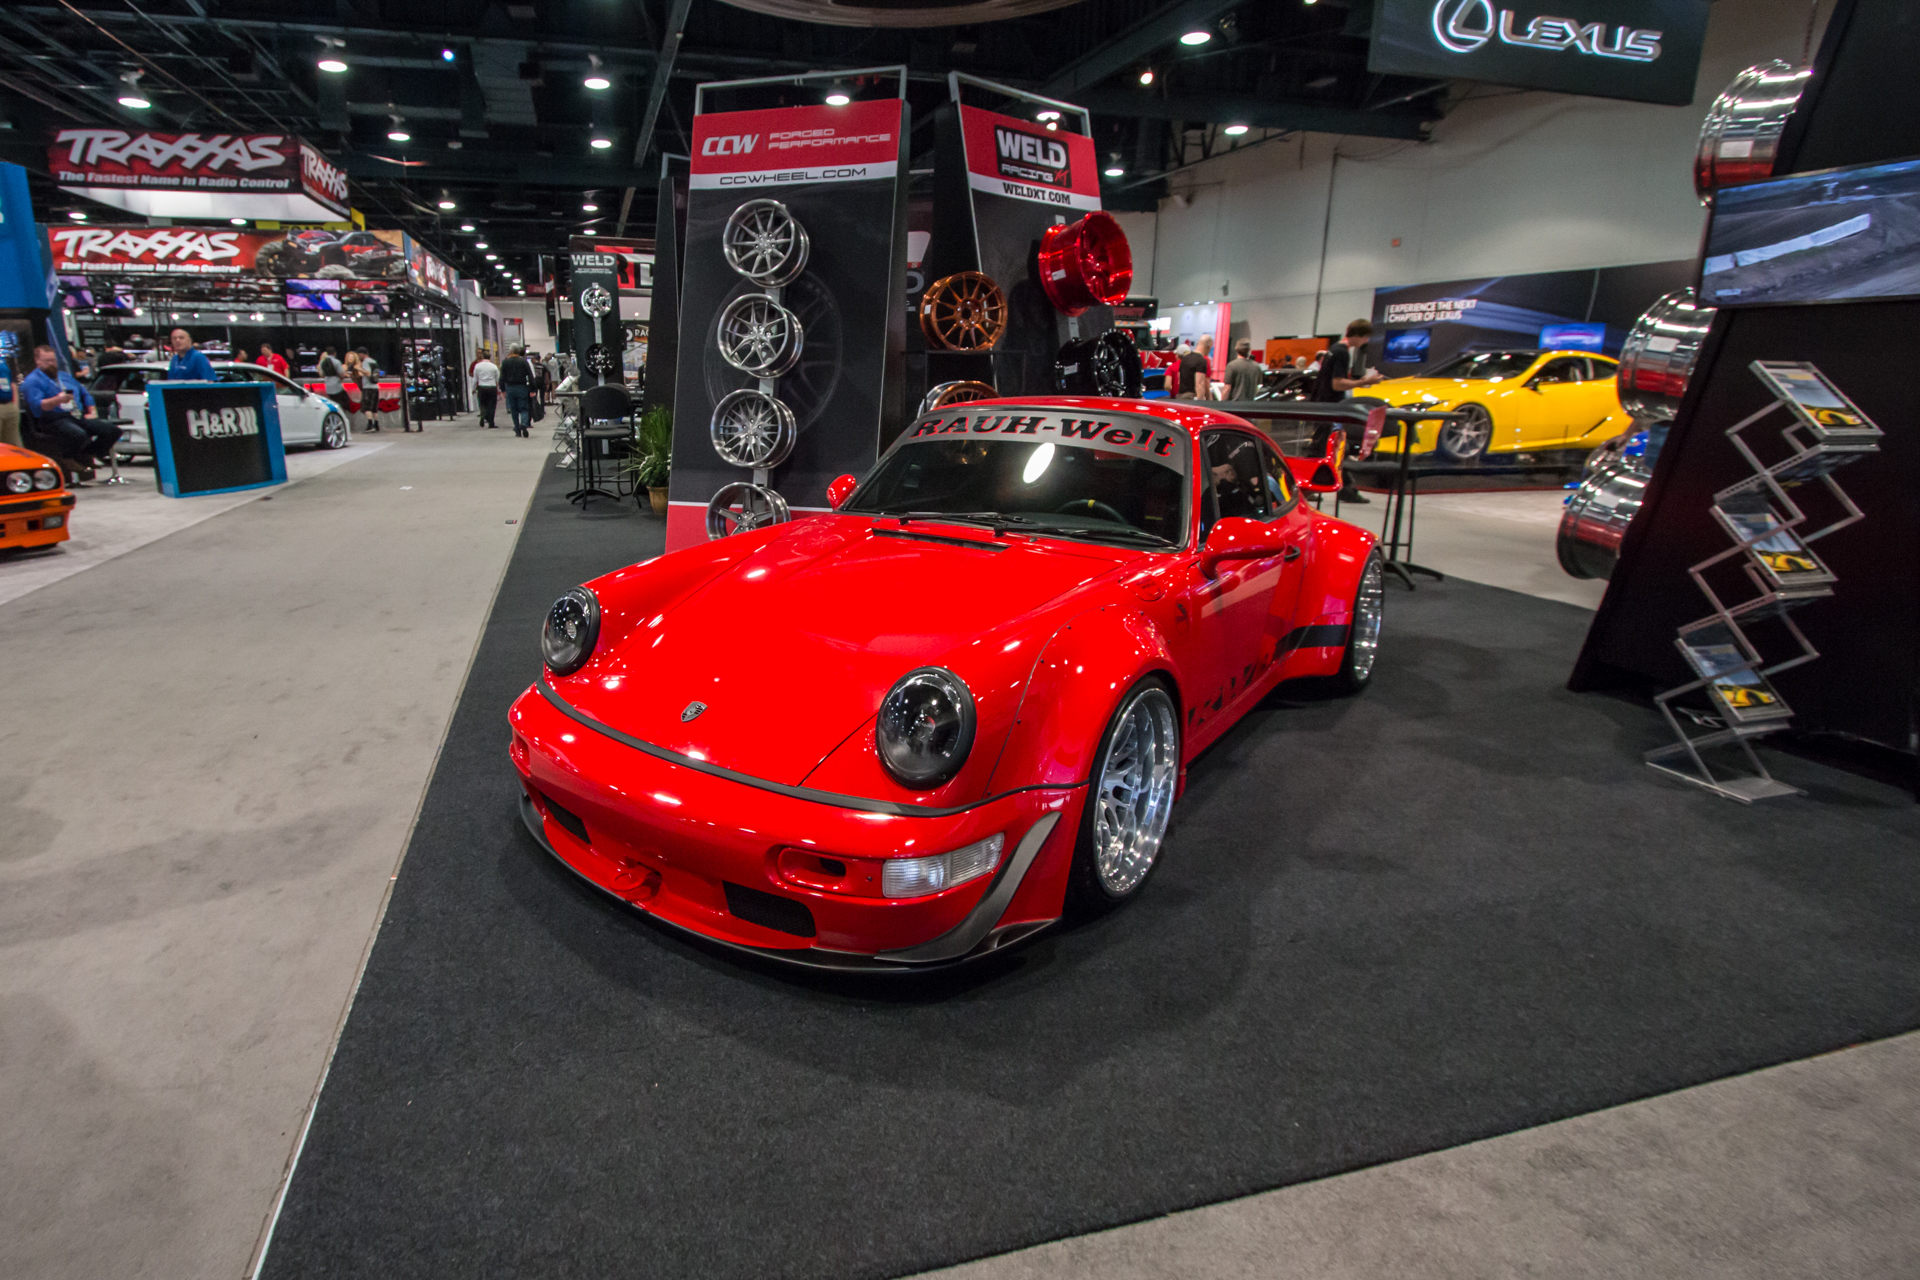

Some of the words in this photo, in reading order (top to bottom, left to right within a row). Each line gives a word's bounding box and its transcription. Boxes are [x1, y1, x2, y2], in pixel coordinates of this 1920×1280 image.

[1499, 9, 1663, 62] LEXUS
[768, 133, 892, 150] PERFORMANCE
[769, 128, 835, 140] FORGED
[55, 129, 286, 171] TRAXXAS
[701, 133, 760, 156] CCW
[997, 129, 1067, 169] WELD
[58, 170, 84, 182] The
[87, 172, 138, 184] Fastest
[141, 175, 180, 186] Name
[182, 176, 196, 187] In
[199, 177, 237, 188] Radio
[239, 178, 290, 189] Control
[719, 167, 867, 185] CCWHEEL.COM
[1001, 163, 1054, 183] RACING
[1002, 182, 1072, 205] WELDXT.COM
[53, 229, 240, 261] TRAXXAS
[61, 261, 81, 271] The
[82, 261, 122, 271] Fastest
[123, 262, 154, 272] Name
[155, 263, 168, 272] In
[168, 263, 200, 273] Radio
[200, 263, 241, 274] Control
[571, 254, 615, 267] WELD
[1389, 302, 1437, 313] EXPERIENCE
[1438, 301, 1454, 310] THE
[1454, 299, 1478, 309] NEXT
[1388, 312, 1423, 323] CHAPTER
[1423, 311, 1436, 322] OF
[1435, 310, 1463, 321] LEXUS
[186, 407, 240, 440] H&R
[908, 415, 1176, 457] RAUH-Welt
